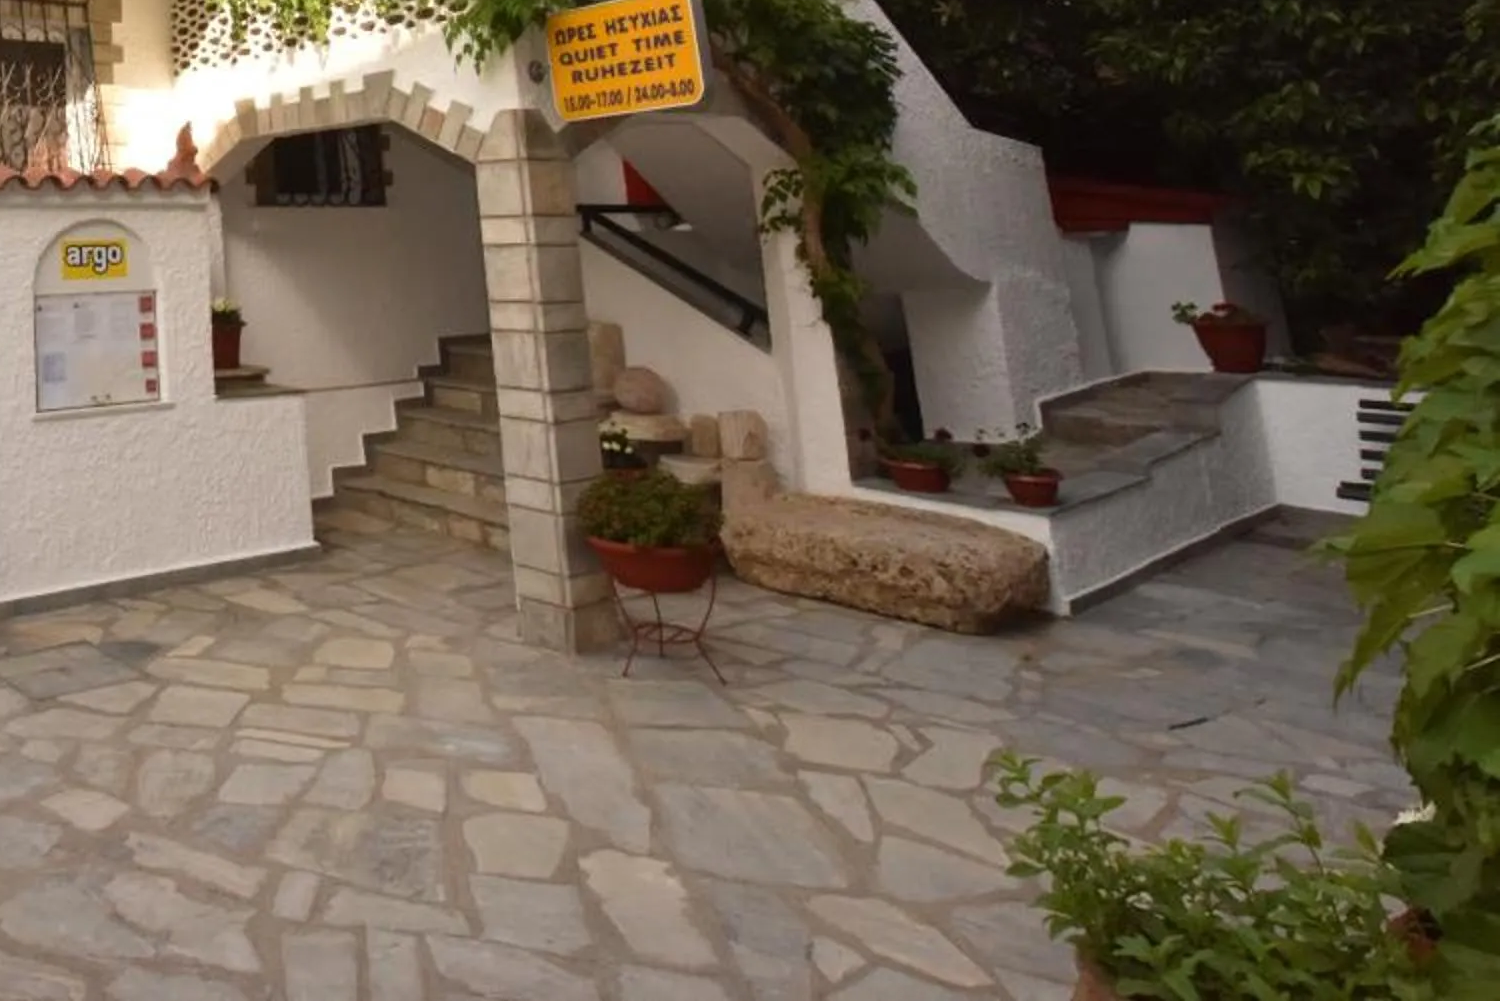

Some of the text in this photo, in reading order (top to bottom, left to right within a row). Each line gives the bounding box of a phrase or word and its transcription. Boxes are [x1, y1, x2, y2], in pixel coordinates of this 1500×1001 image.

[554, 4, 684, 47] ΩΡΕΣ ΗΣΥΧΙΑΣ
[559, 30, 686, 66] QUIET TIME
[571, 53, 676, 84] RUHEZEIT
[64, 243, 124, 275] argo
